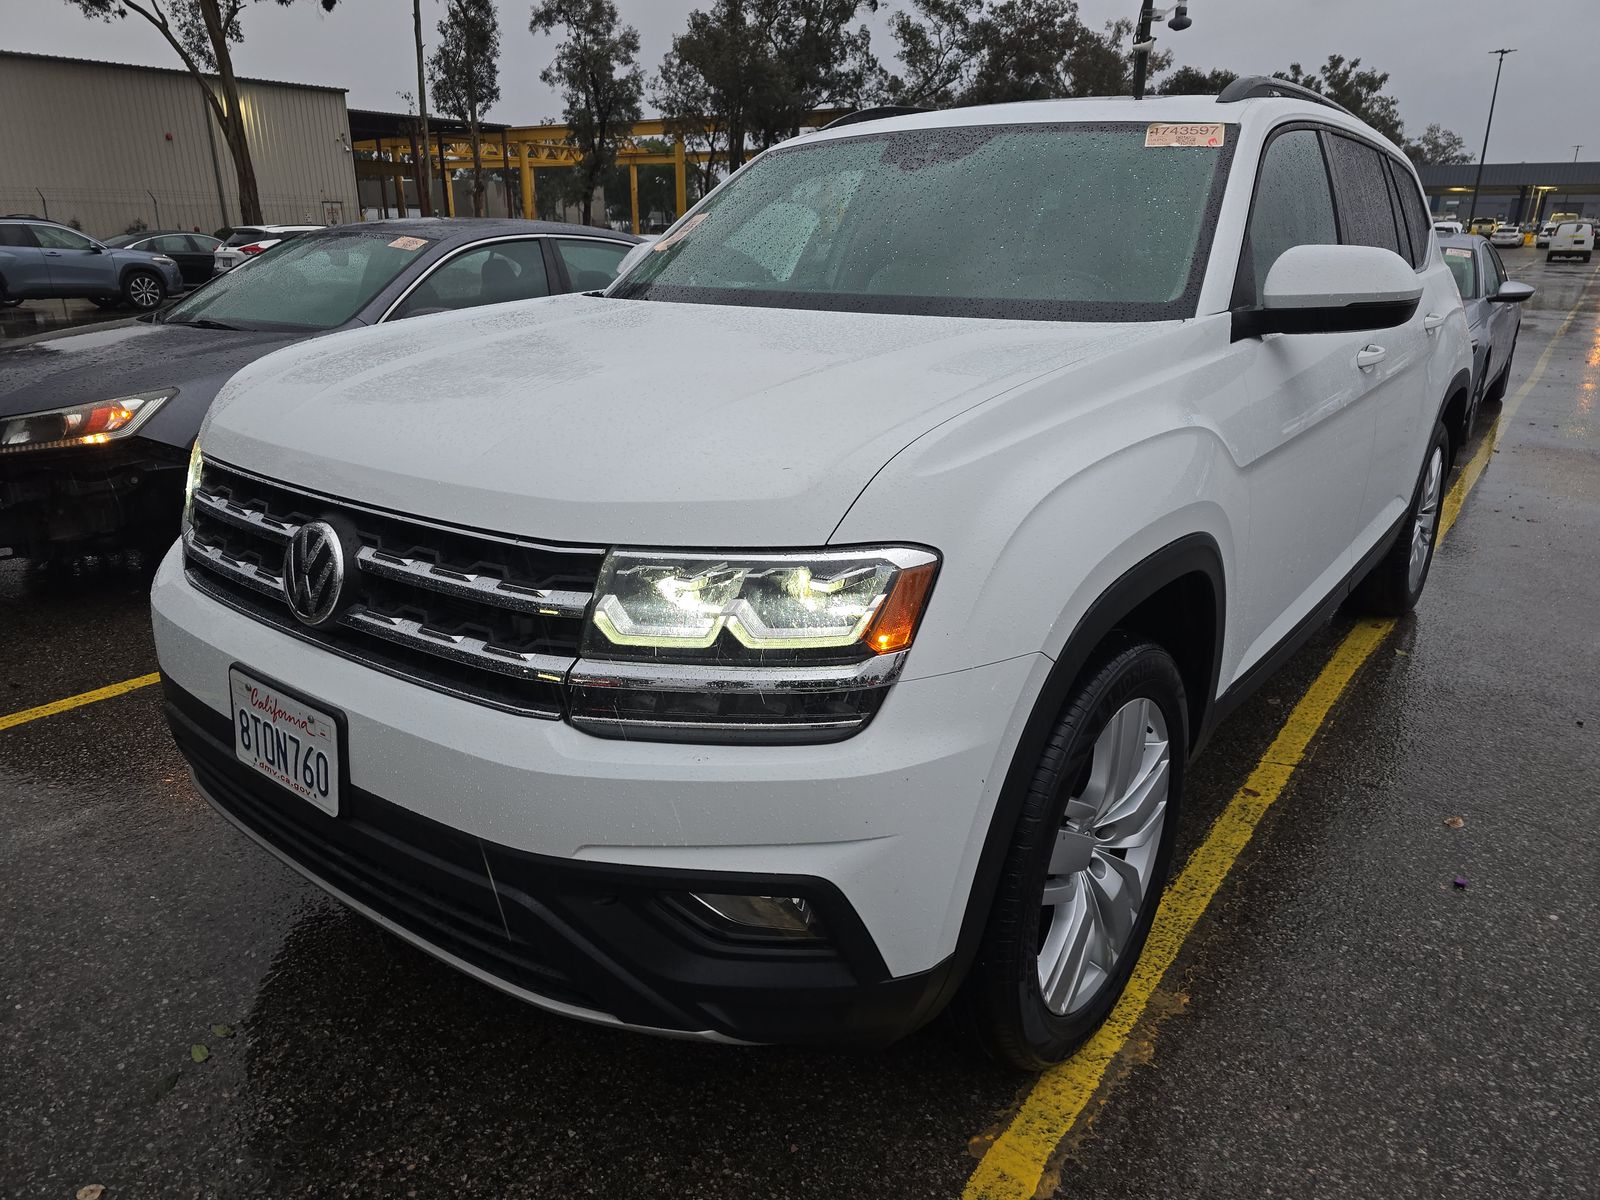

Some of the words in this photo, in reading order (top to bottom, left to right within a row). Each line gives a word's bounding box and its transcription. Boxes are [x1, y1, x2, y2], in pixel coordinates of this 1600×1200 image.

[1149, 126, 1220, 136] 4743597
[250, 687, 316, 737] California
[238, 708, 329, 798] 8TON760
[259, 761, 312, 797] dmv.ca.gov
